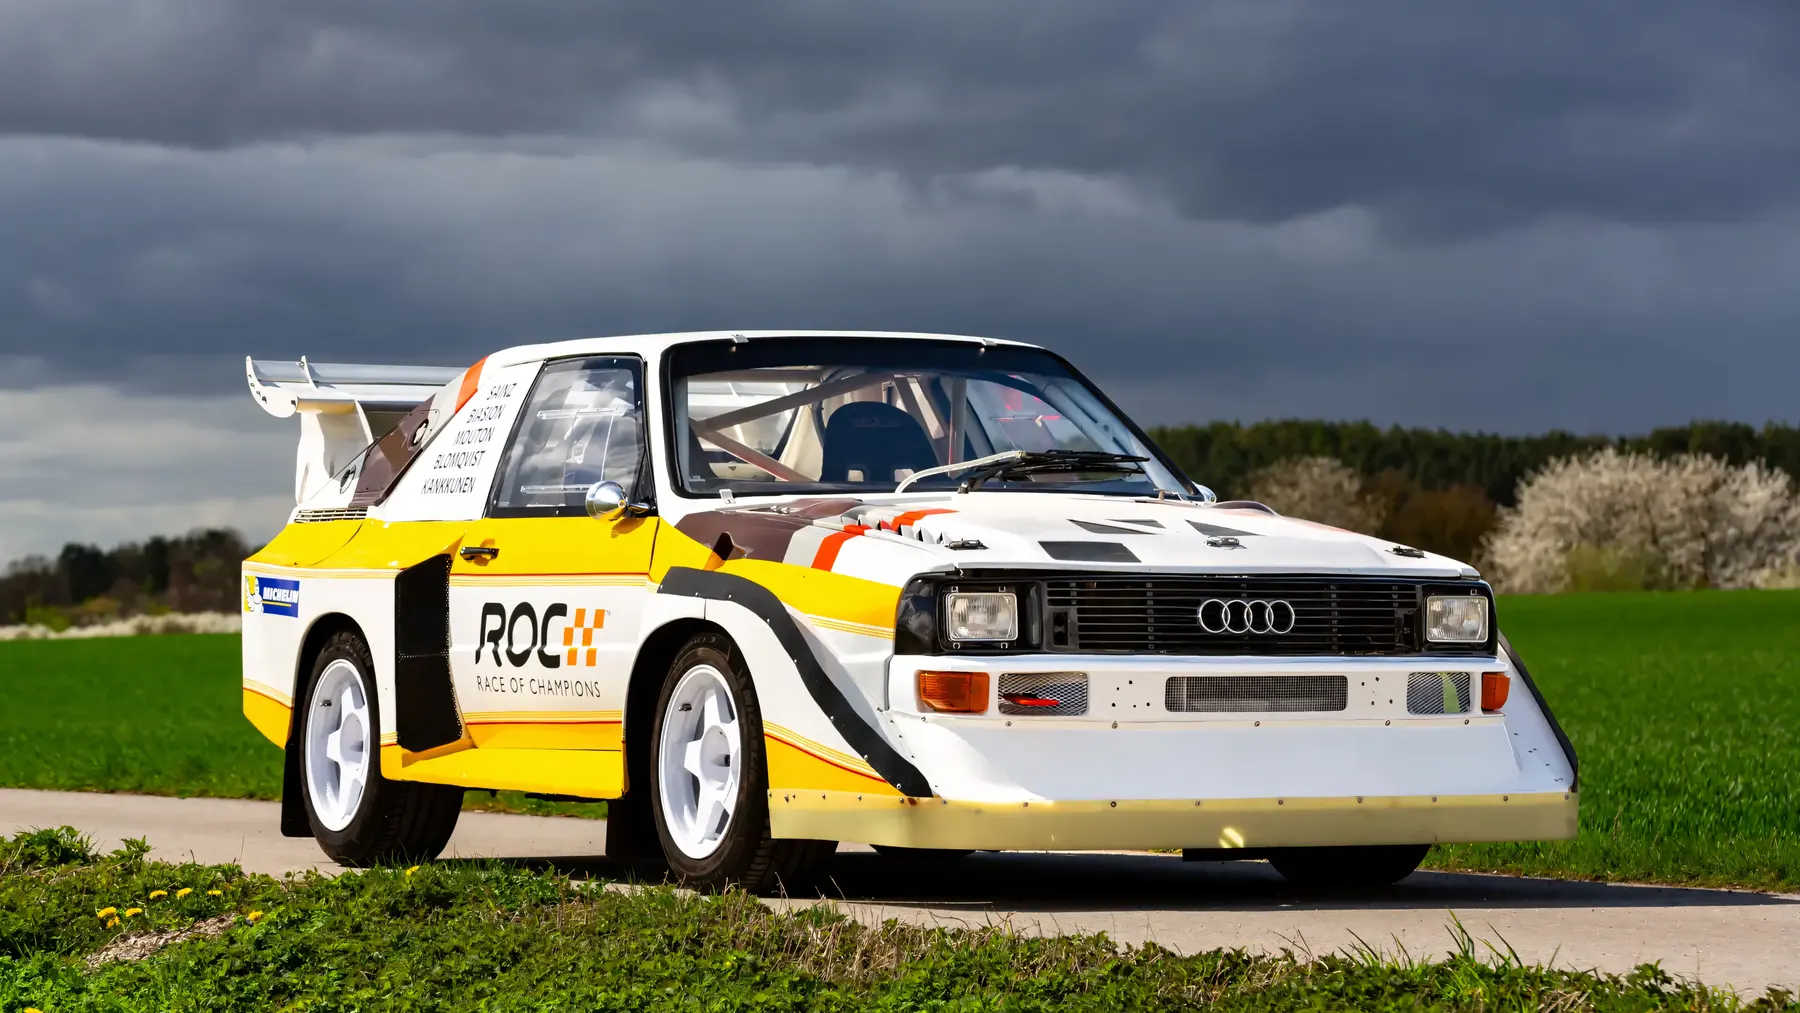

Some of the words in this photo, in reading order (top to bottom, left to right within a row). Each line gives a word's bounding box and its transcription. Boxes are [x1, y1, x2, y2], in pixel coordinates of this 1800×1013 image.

[486, 382, 518, 400] SAINZ
[466, 404, 507, 424] BIASION
[452, 426, 496, 446] MOUTON
[433, 450, 486, 469] BLOMQVIST
[421, 476, 476, 495] KANKKUNEN
[262, 586, 300, 604] MICHELIN
[475, 601, 568, 669] ROC
[476, 675, 506, 692] RACE
[510, 677, 524, 693] OF
[529, 678, 601, 698] CHAMPIONS
